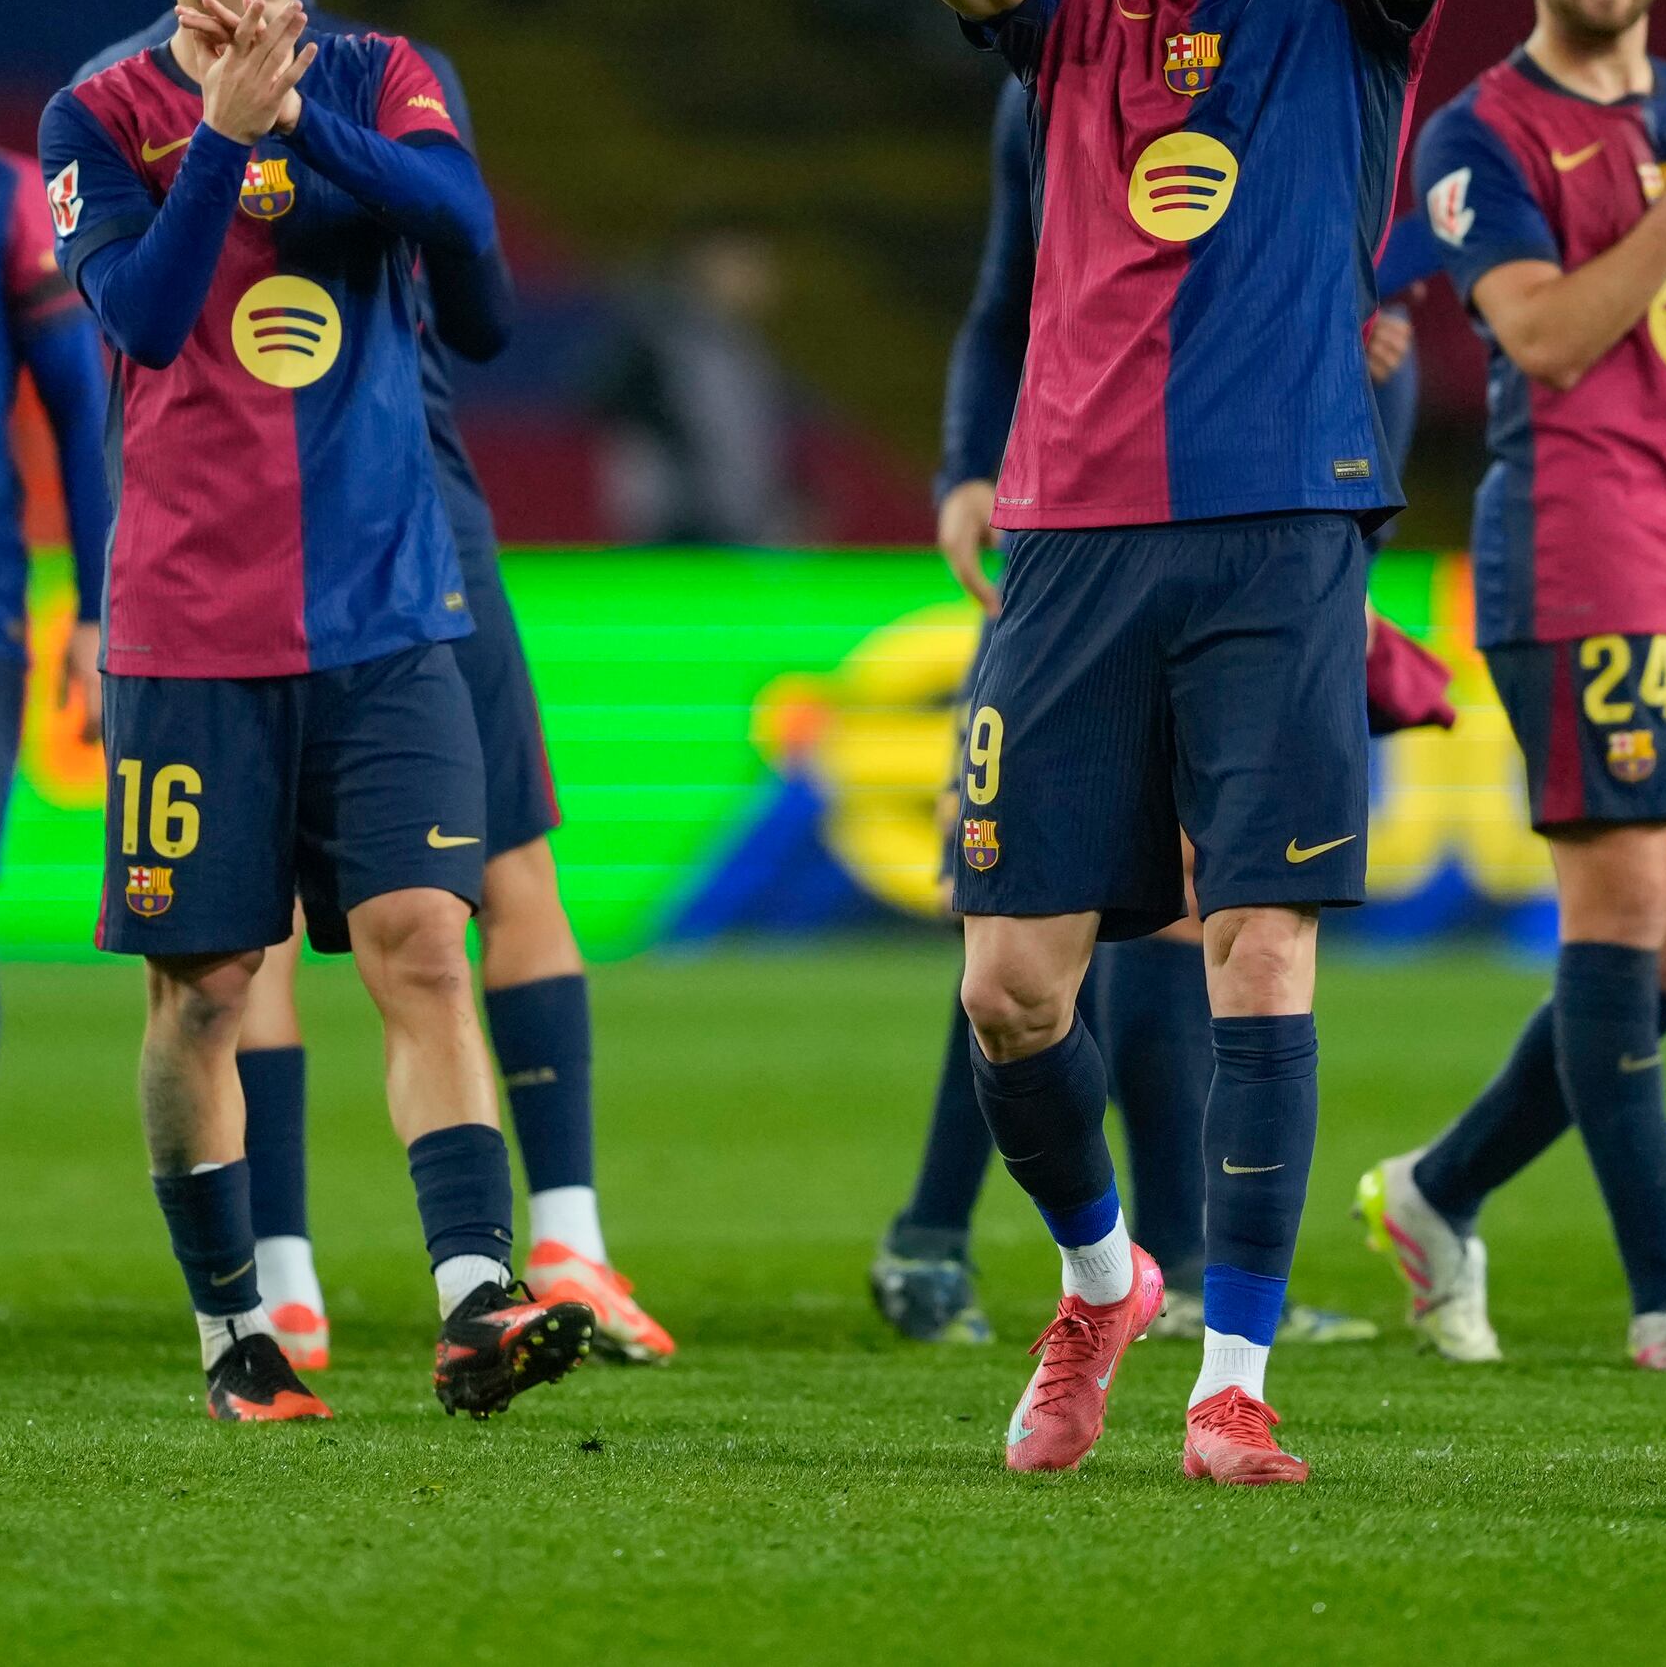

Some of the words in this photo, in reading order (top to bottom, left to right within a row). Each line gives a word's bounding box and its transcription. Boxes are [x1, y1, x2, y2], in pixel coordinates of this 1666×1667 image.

[1180, 58, 1204, 67] FCB
[967, 706, 1004, 805] 9
[117, 758, 202, 859] 16
